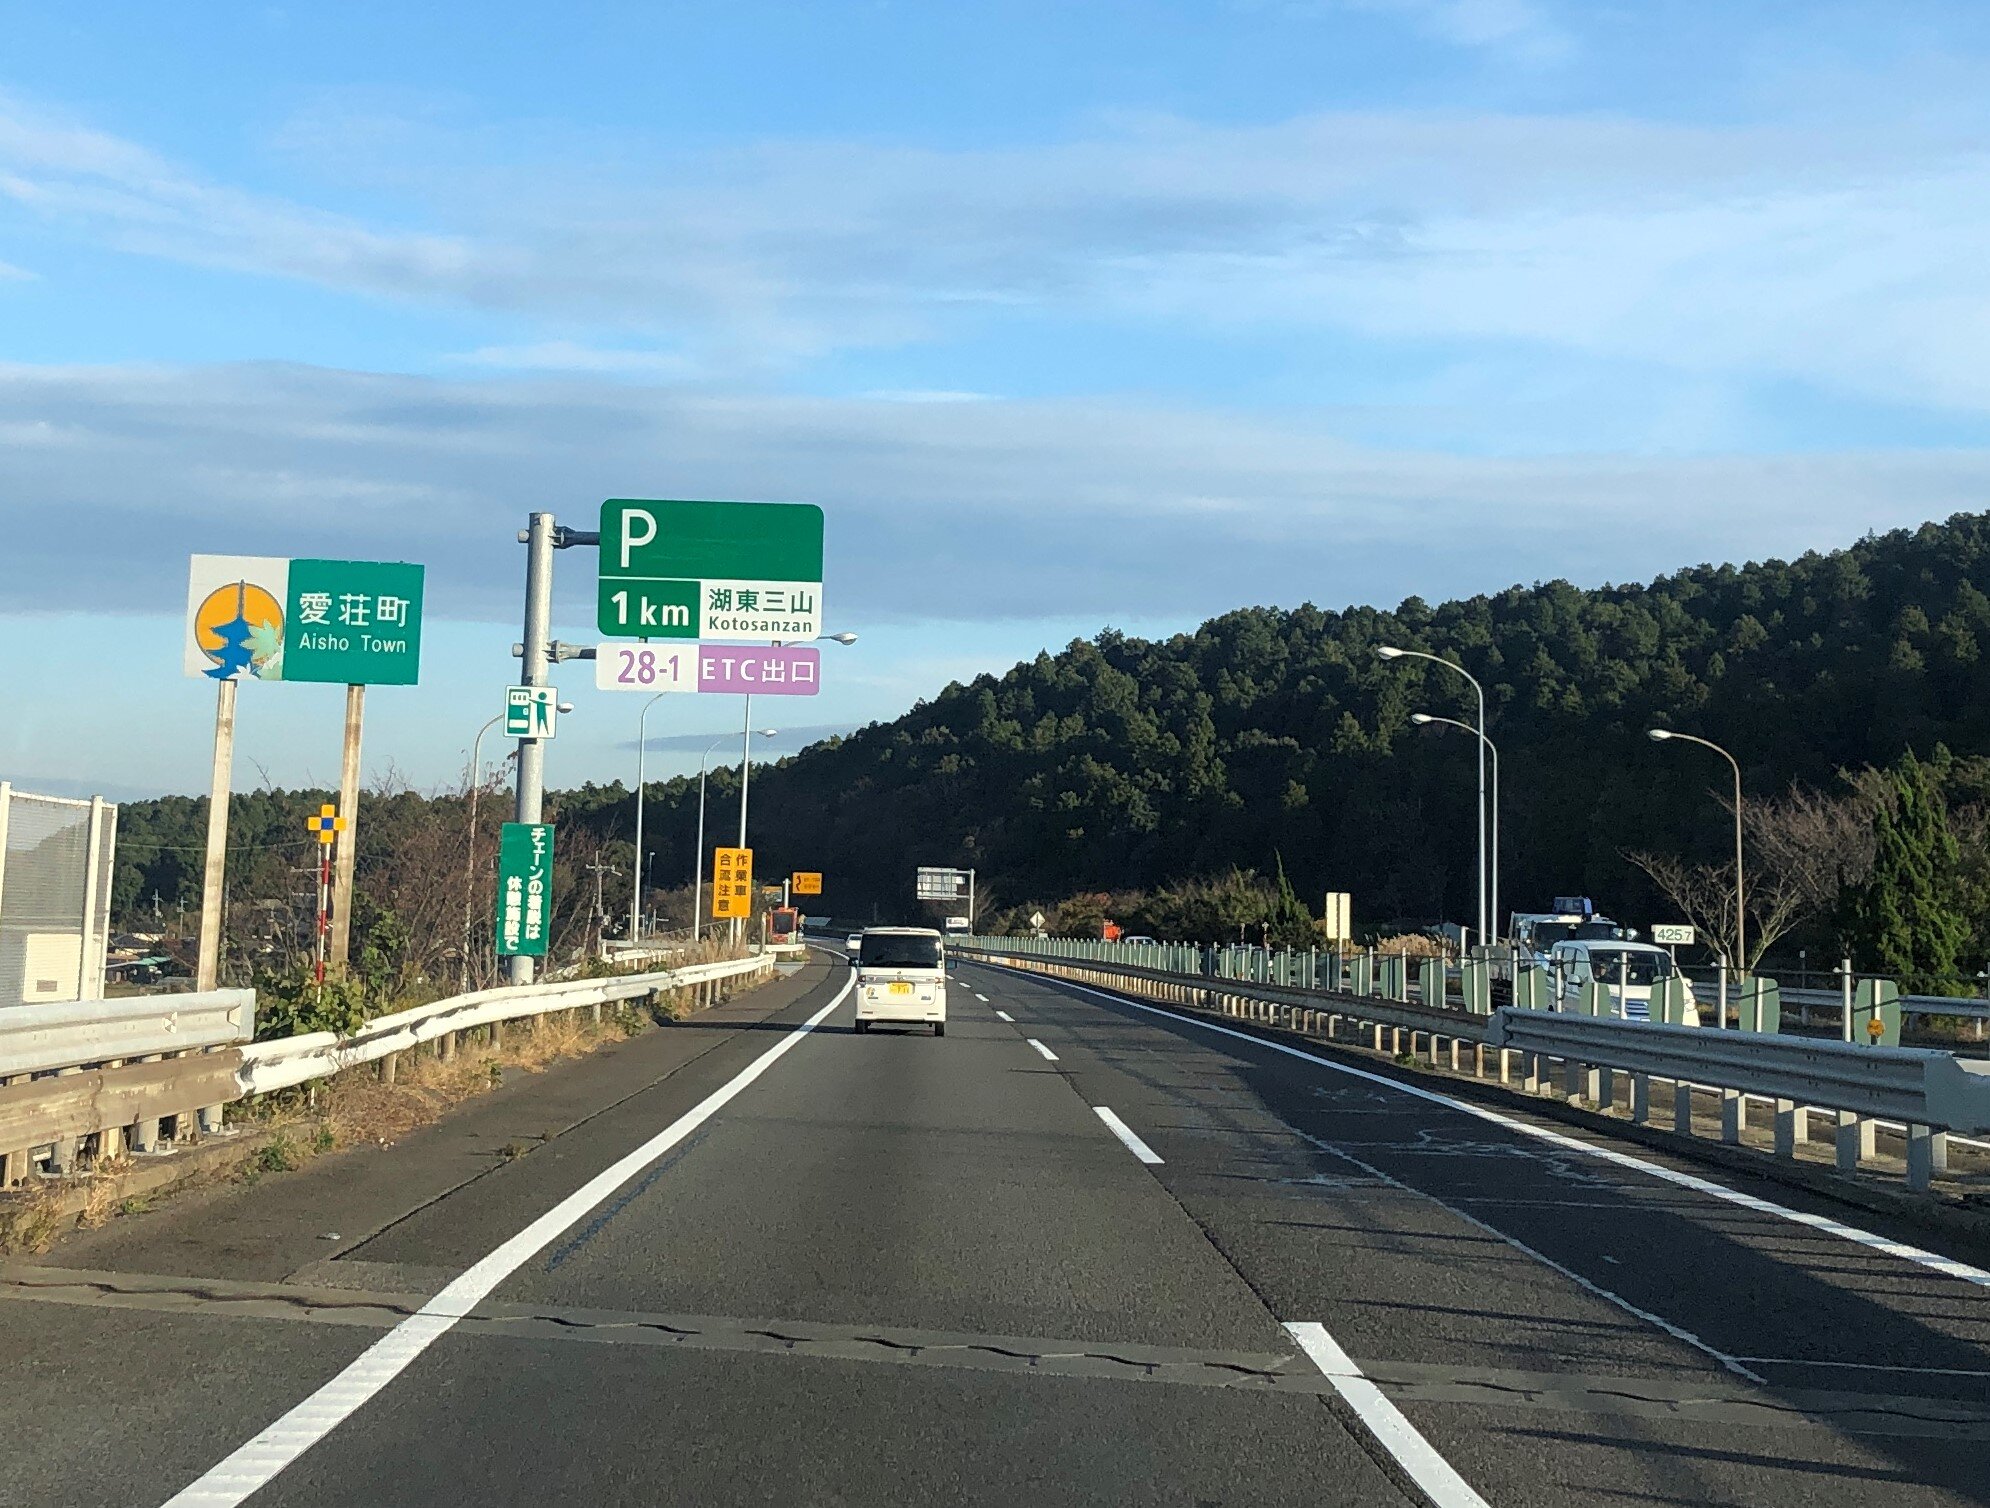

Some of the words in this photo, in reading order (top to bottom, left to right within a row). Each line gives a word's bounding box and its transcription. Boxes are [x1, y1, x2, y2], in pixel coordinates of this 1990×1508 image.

[620, 508, 658, 568] P
[298, 592, 411, 628] 愛荘町
[610, 590, 628, 625] 1
[640, 596, 690, 626] km
[709, 588, 813, 615] 湖東三山
[709, 616, 812, 633] Kotosanzan
[298, 632, 350, 651] Aisho
[361, 634, 407, 654] Town
[617, 650, 680, 684] 28-1
